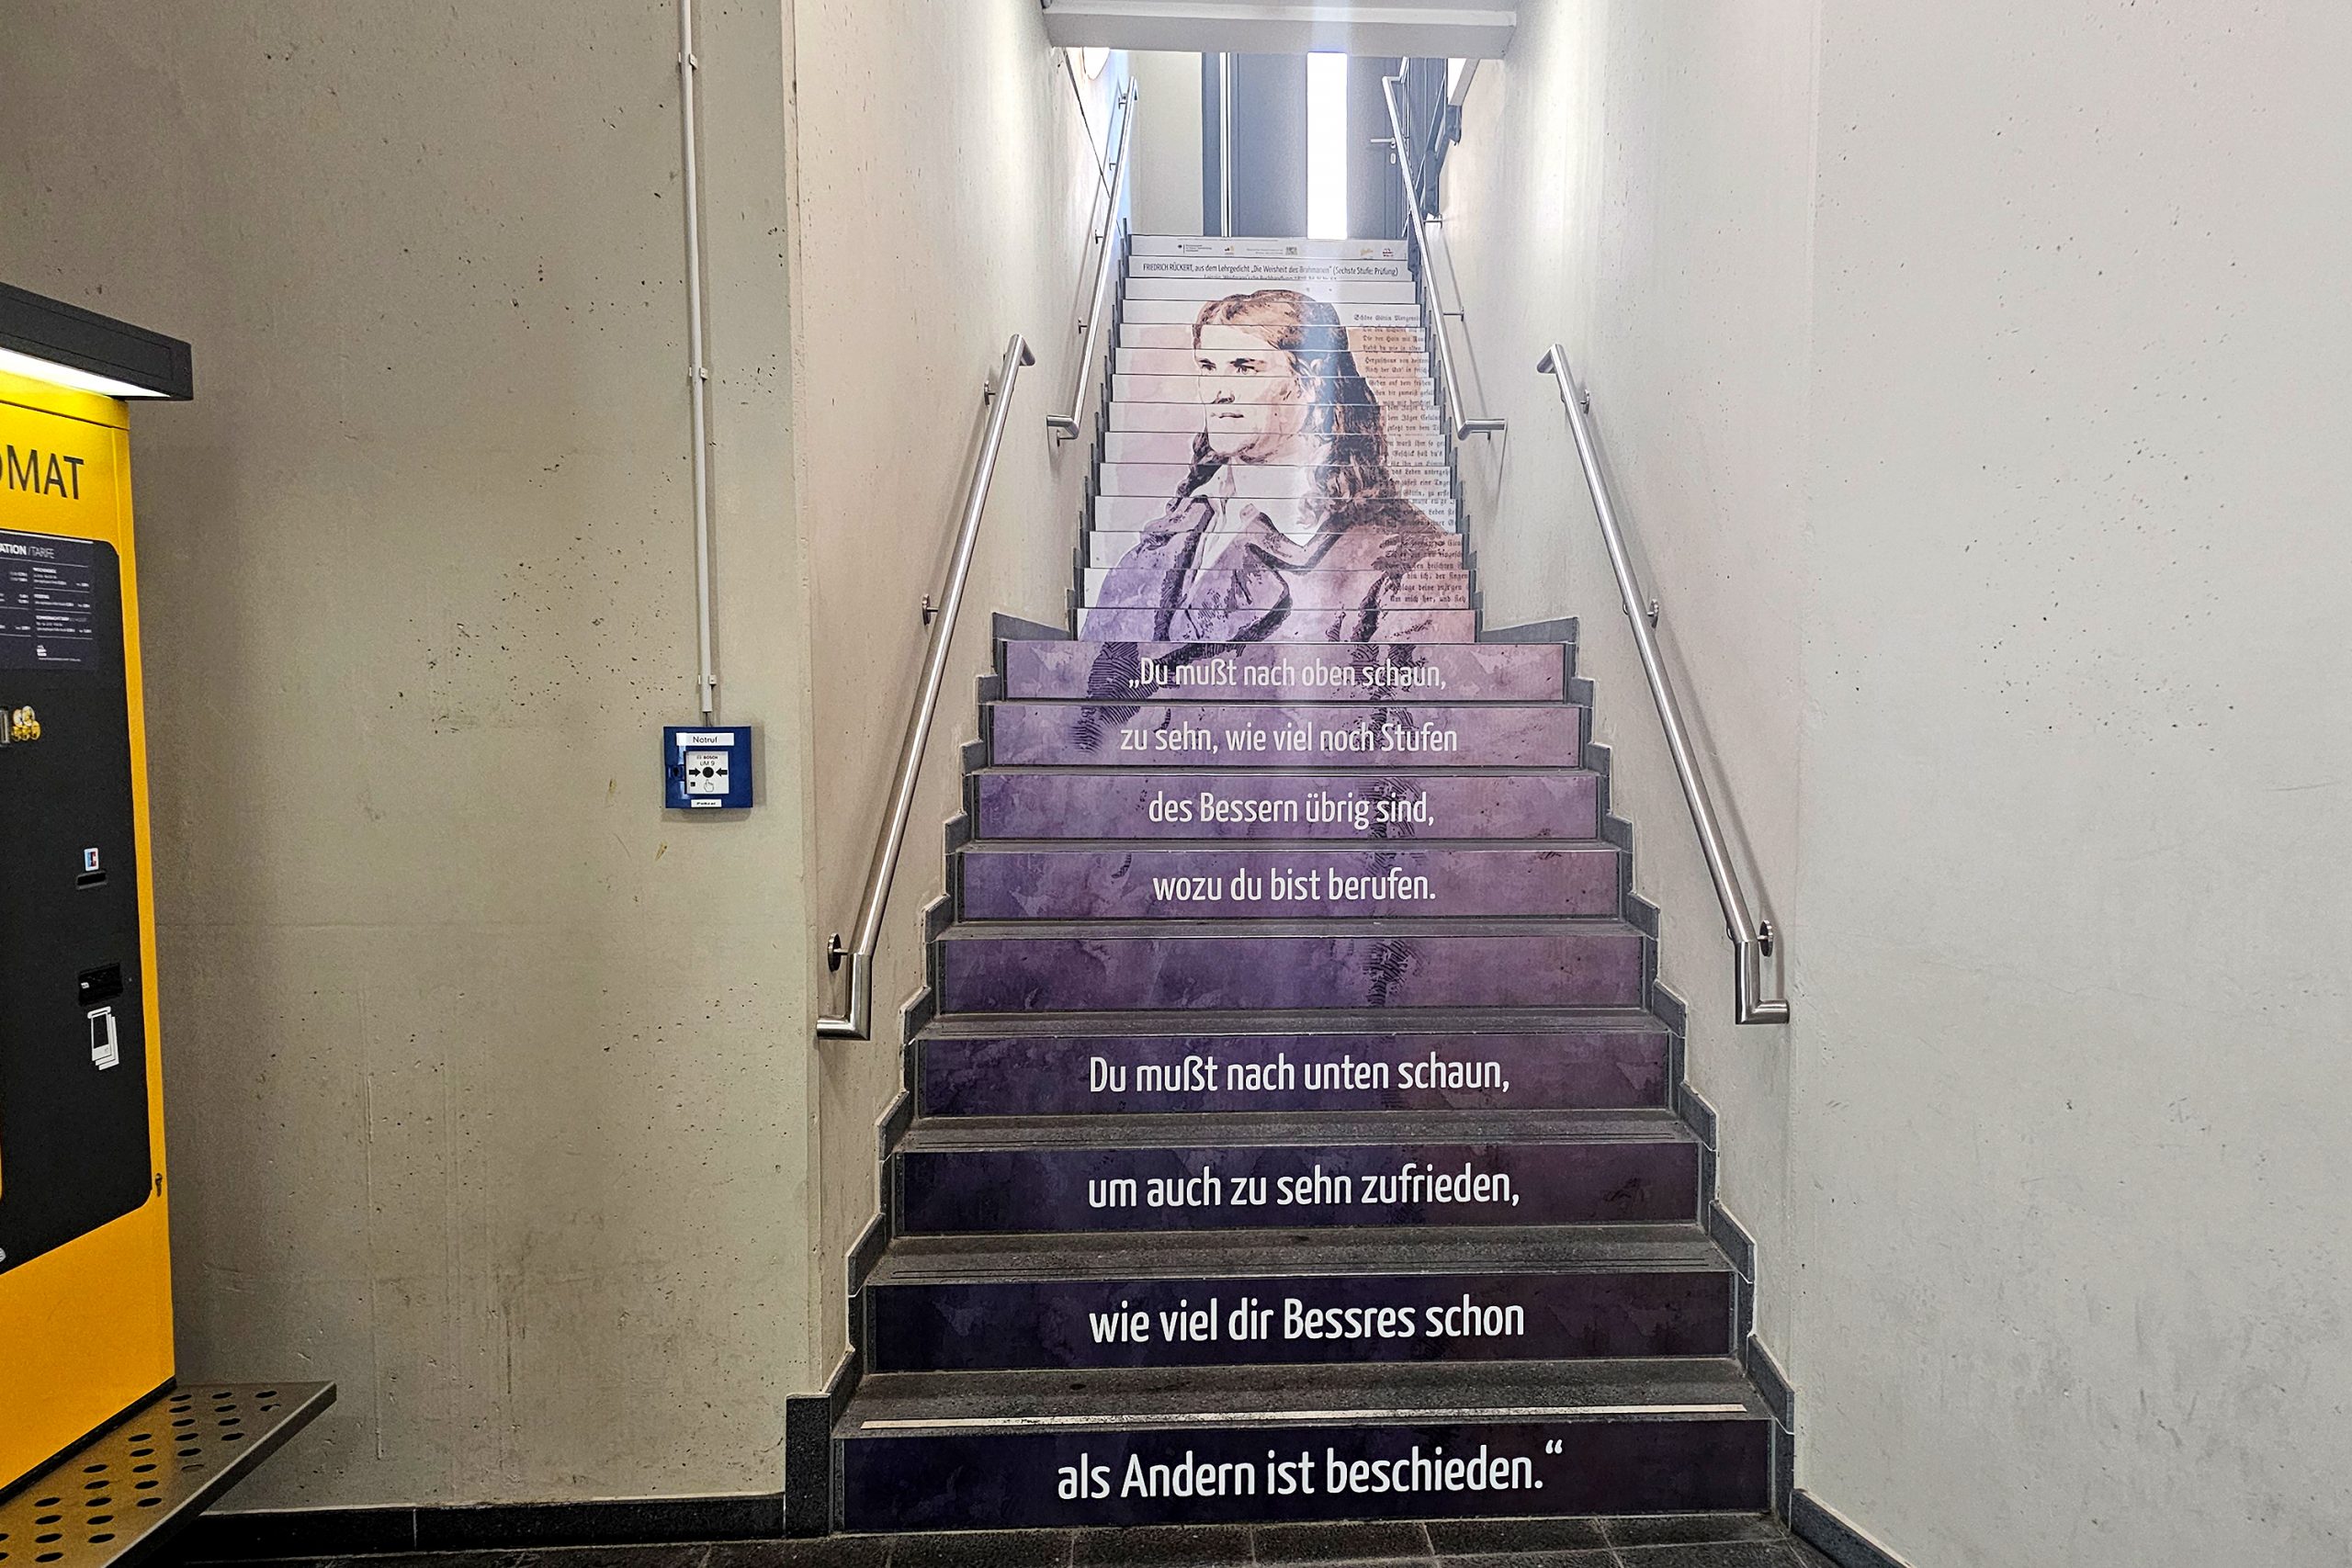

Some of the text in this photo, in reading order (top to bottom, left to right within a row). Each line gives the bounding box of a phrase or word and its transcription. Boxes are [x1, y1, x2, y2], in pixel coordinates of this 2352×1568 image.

[1143, 262, 1169, 272] FRIEDRICH
[1170, 261, 1194, 273] RÜCKERT,
[1205, 264, 1217, 273] dem
[1217, 264, 1250, 275] Lehrgedicht
[1262, 265, 1288, 274] Weisheit
[1289, 265, 1298, 274] des
[1374, 266, 1398, 276] Prüfung)
[0, 442, 85, 501] MAT
[1128, 657, 1447, 690] „Du mußt nach oben schaun,
[693, 736, 718, 744] Notruf
[1120, 721, 1457, 754] zu sehn, wie viel noch Stufen
[1148, 790, 1435, 830] des Bessern übrig sind,
[1152, 867, 1436, 901] wozu du bist berufen.
[1090, 1052, 1510, 1093] Du mußt nach unten schaun,
[1089, 1163, 1520, 1208] um auch zu sehn zufrieden,
[1089, 1293, 1524, 1343] wie viel dir Bessres schon
[1057, 1452, 1111, 1500] als
[1120, 1450, 1255, 1498] Andern
[1267, 1450, 1316, 1495] ist
